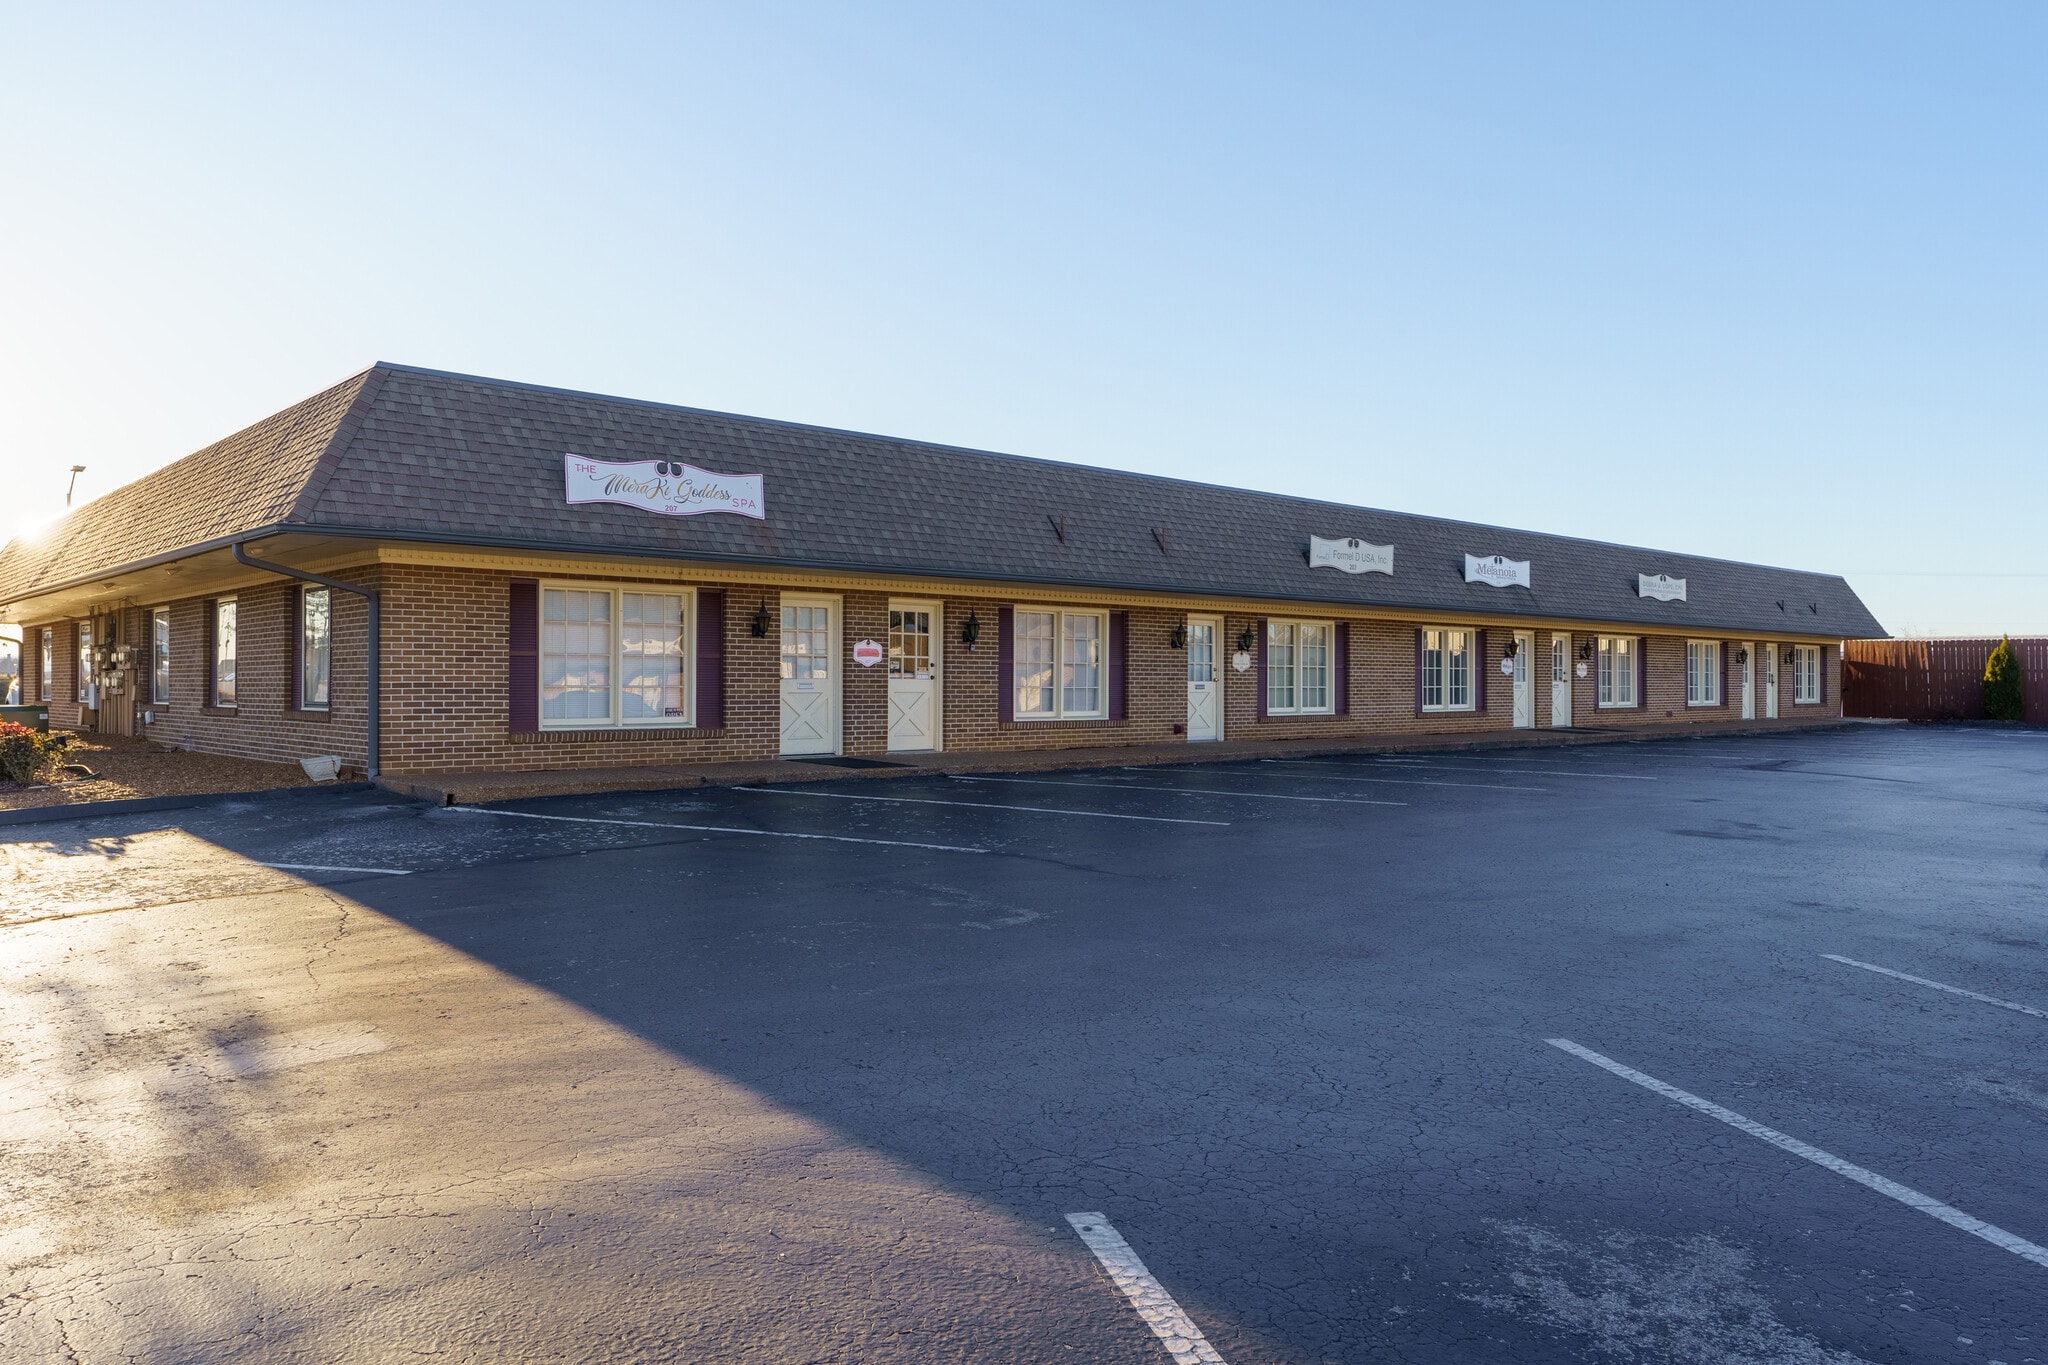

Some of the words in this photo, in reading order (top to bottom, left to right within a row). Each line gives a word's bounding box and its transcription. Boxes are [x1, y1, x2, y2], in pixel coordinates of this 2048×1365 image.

[575, 463, 597, 474] THE
[674, 479, 732, 504] Goddess
[665, 504, 678, 512] 207
[732, 498, 757, 509] SPA
[1333, 550, 1354, 561] Formel
[1355, 552, 1360, 562] D
